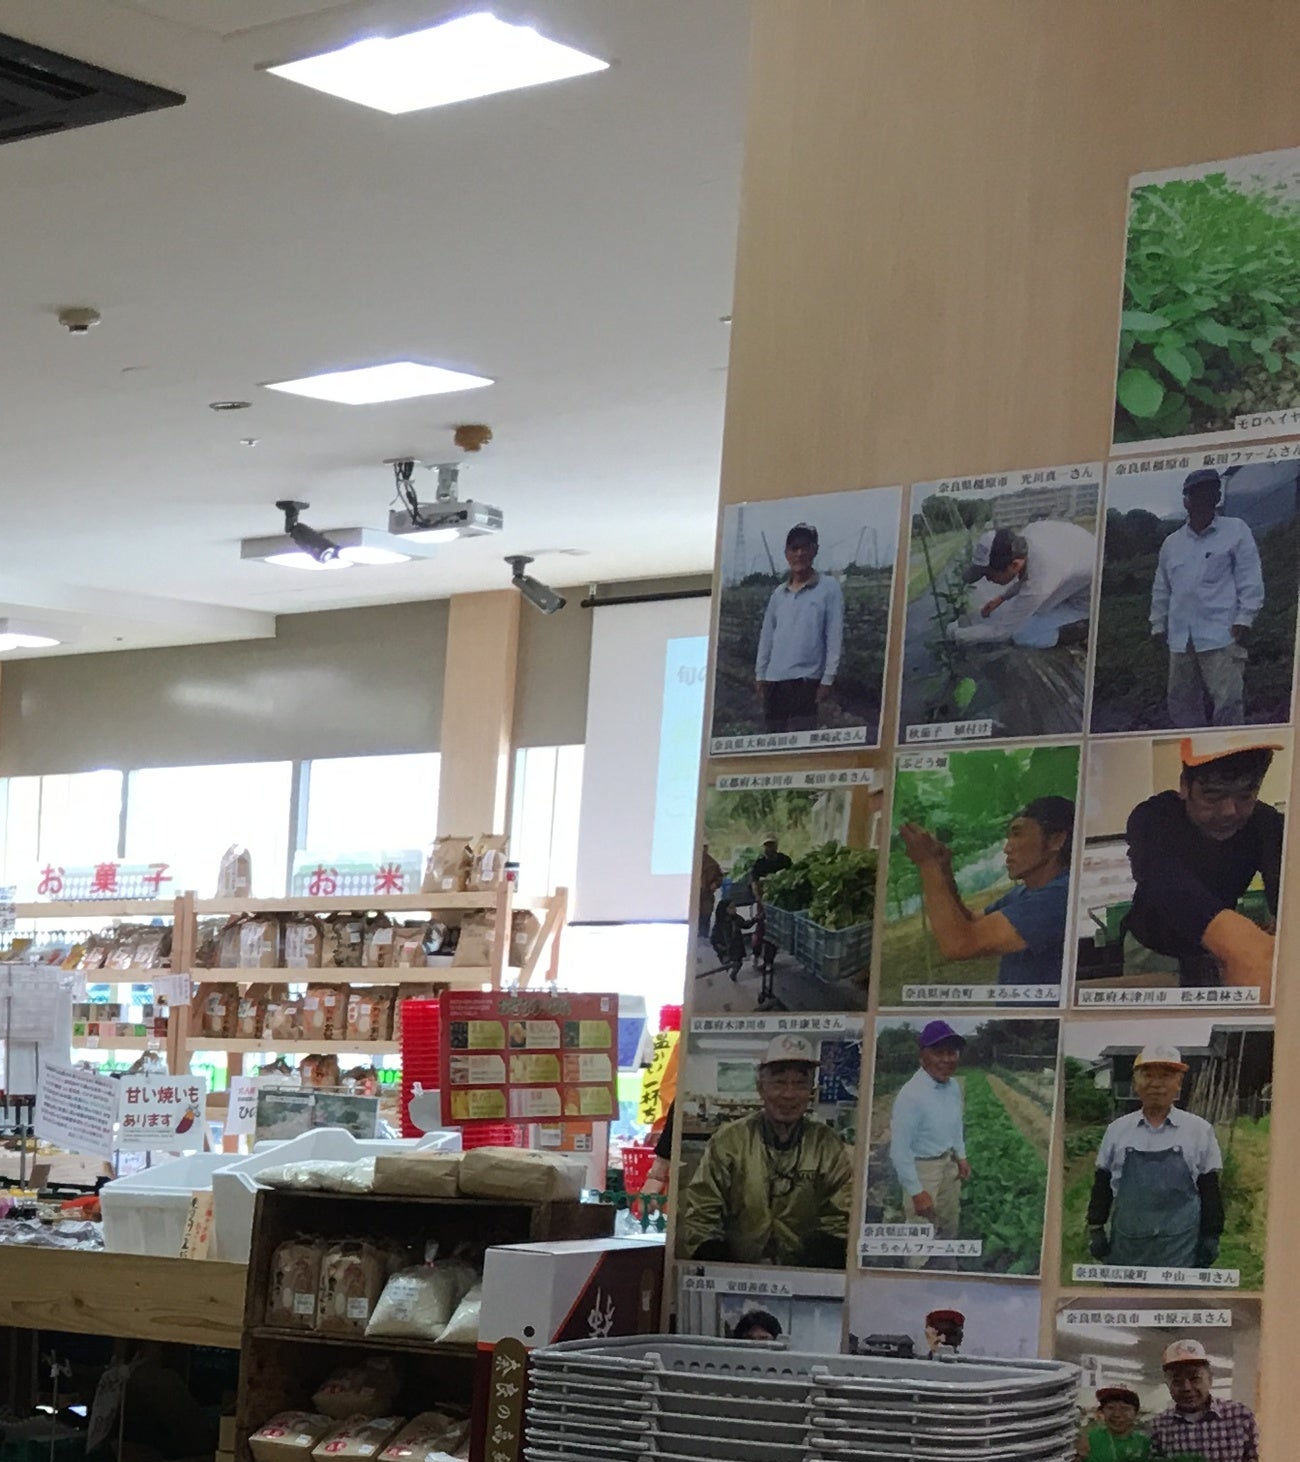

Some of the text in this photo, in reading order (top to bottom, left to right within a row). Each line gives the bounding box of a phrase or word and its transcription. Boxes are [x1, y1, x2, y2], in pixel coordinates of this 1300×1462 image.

[36, 862, 173, 896] お菓子
[309, 862, 404, 897] お米
[125, 1085, 200, 1105] 甘い焼いも
[122, 1112, 173, 1129] あります
